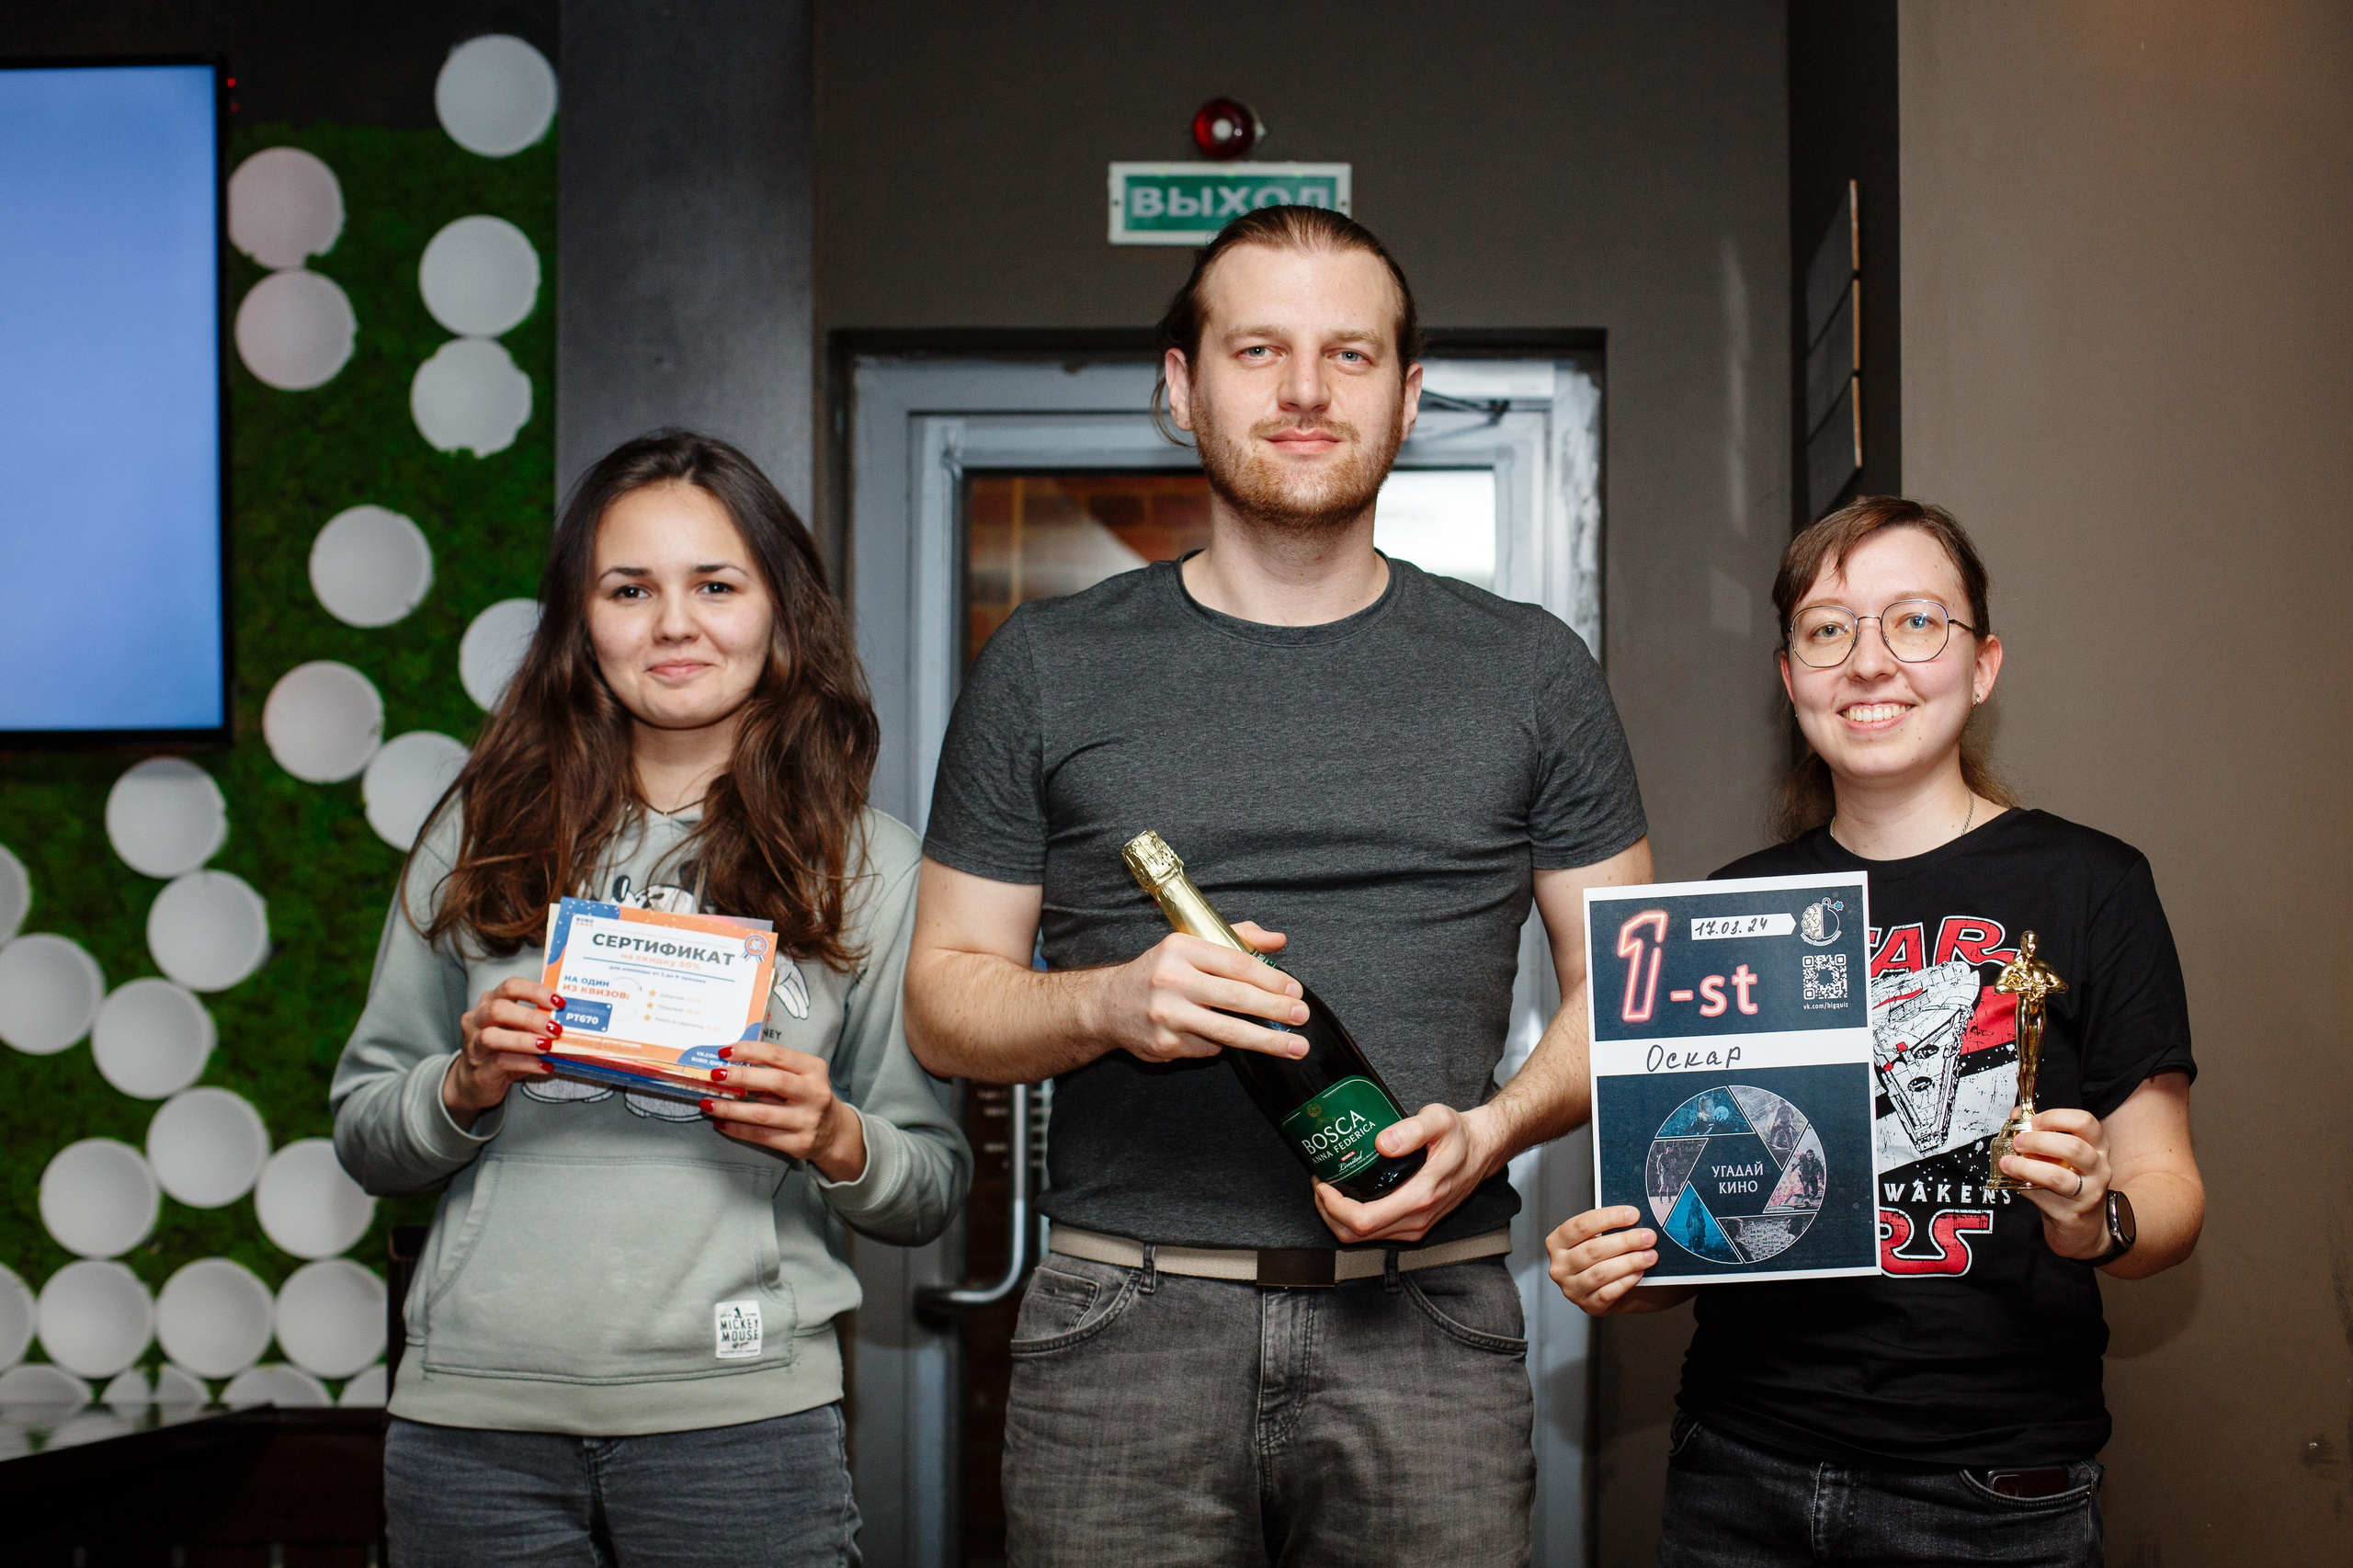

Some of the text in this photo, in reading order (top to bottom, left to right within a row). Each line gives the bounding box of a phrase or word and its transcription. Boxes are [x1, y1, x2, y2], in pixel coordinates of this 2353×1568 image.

[592, 933, 735, 966] СЕРТИФИКАТ
[1870, 915, 2020, 980] AR
[564, 975, 609, 987] НА ОДИН
[563, 983, 630, 1000] ИЗ КВИЗОВ:
[1802, 1001, 1848, 1010] vk.com/bigquiz
[1302, 1109, 1366, 1155] BOSCA
[1312, 1150, 1334, 1165] ANNA
[1333, 1120, 1377, 1153] FEDERICA
[1711, 1160, 1764, 1178] УГАДАЙ
[1719, 1180, 1758, 1195] КИНО
[720, 1318, 758, 1330] MICKEY
[722, 1330, 758, 1342] MOUSE
